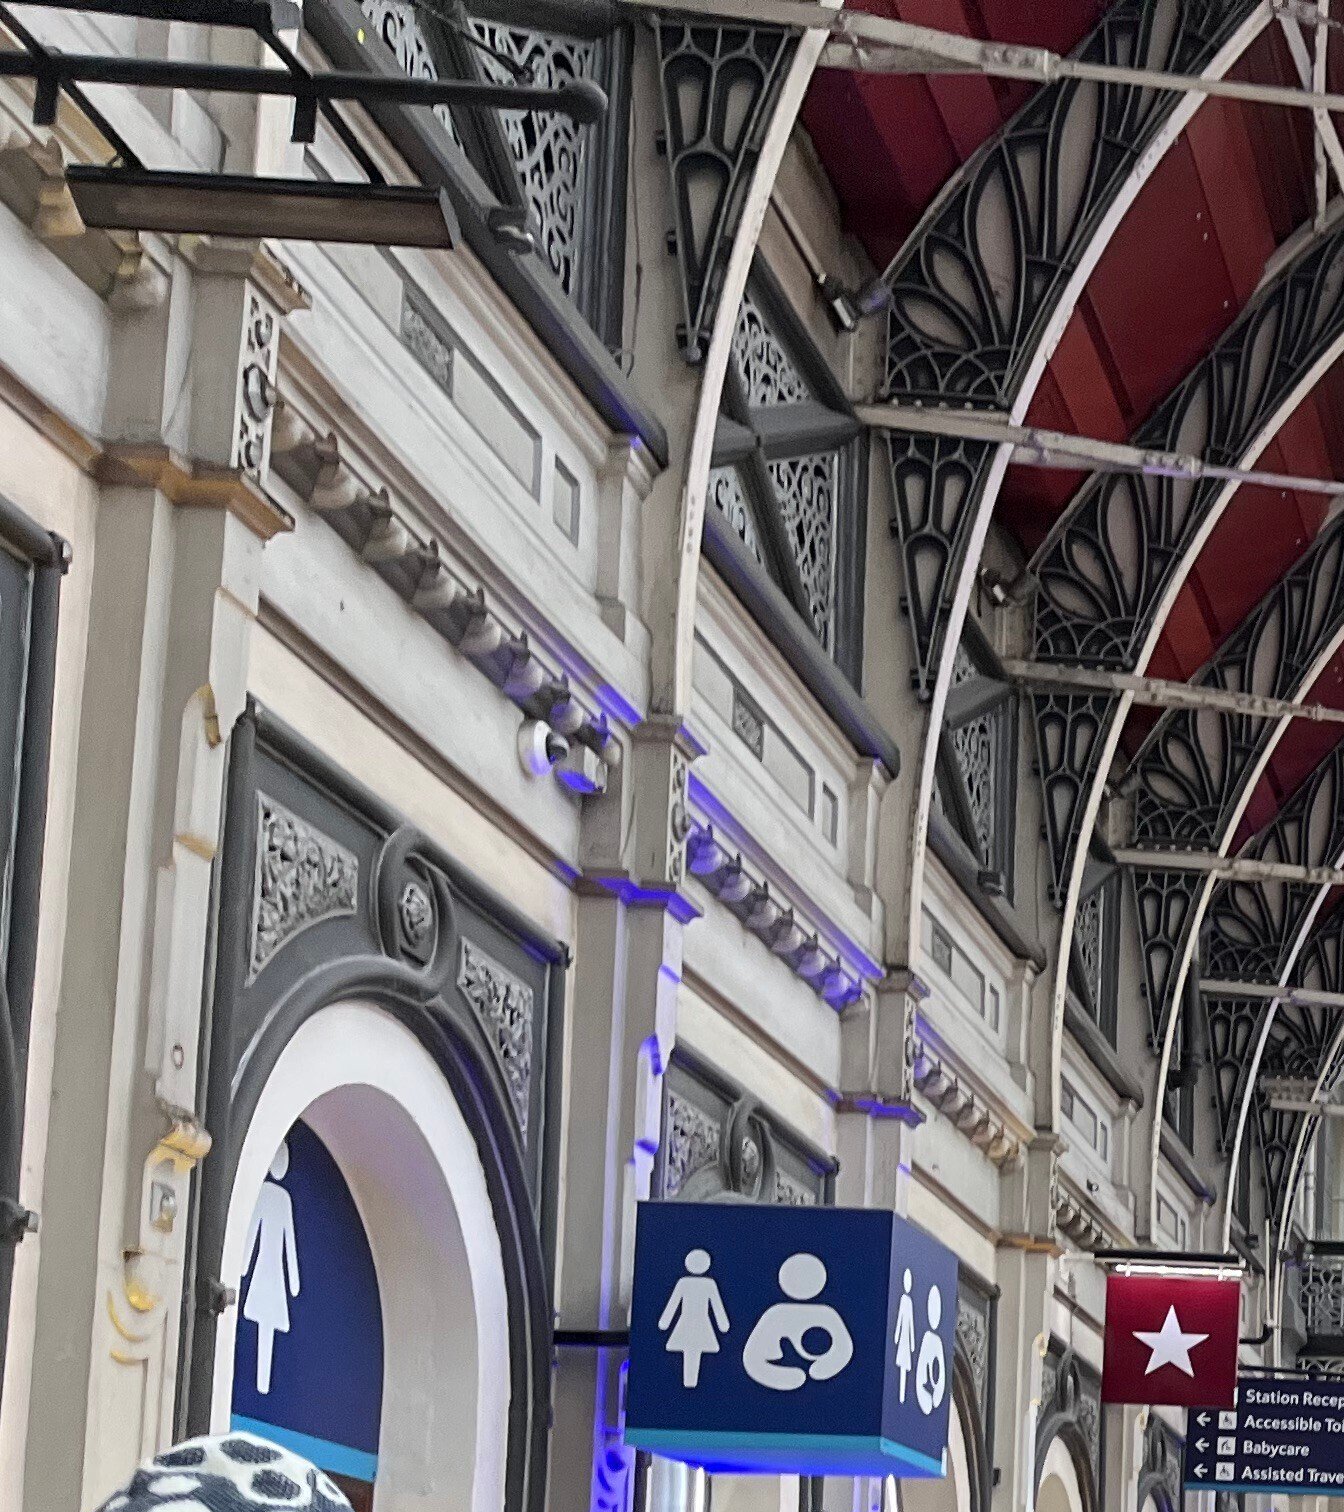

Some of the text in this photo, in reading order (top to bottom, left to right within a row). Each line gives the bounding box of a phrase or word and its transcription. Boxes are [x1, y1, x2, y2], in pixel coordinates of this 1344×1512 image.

[1246, 1388, 1299, 1406] Station
[1244, 1414, 1322, 1432] Accessible
[1243, 1440, 1310, 1458] Babycare
[1242, 1466, 1304, 1482] Assisted
